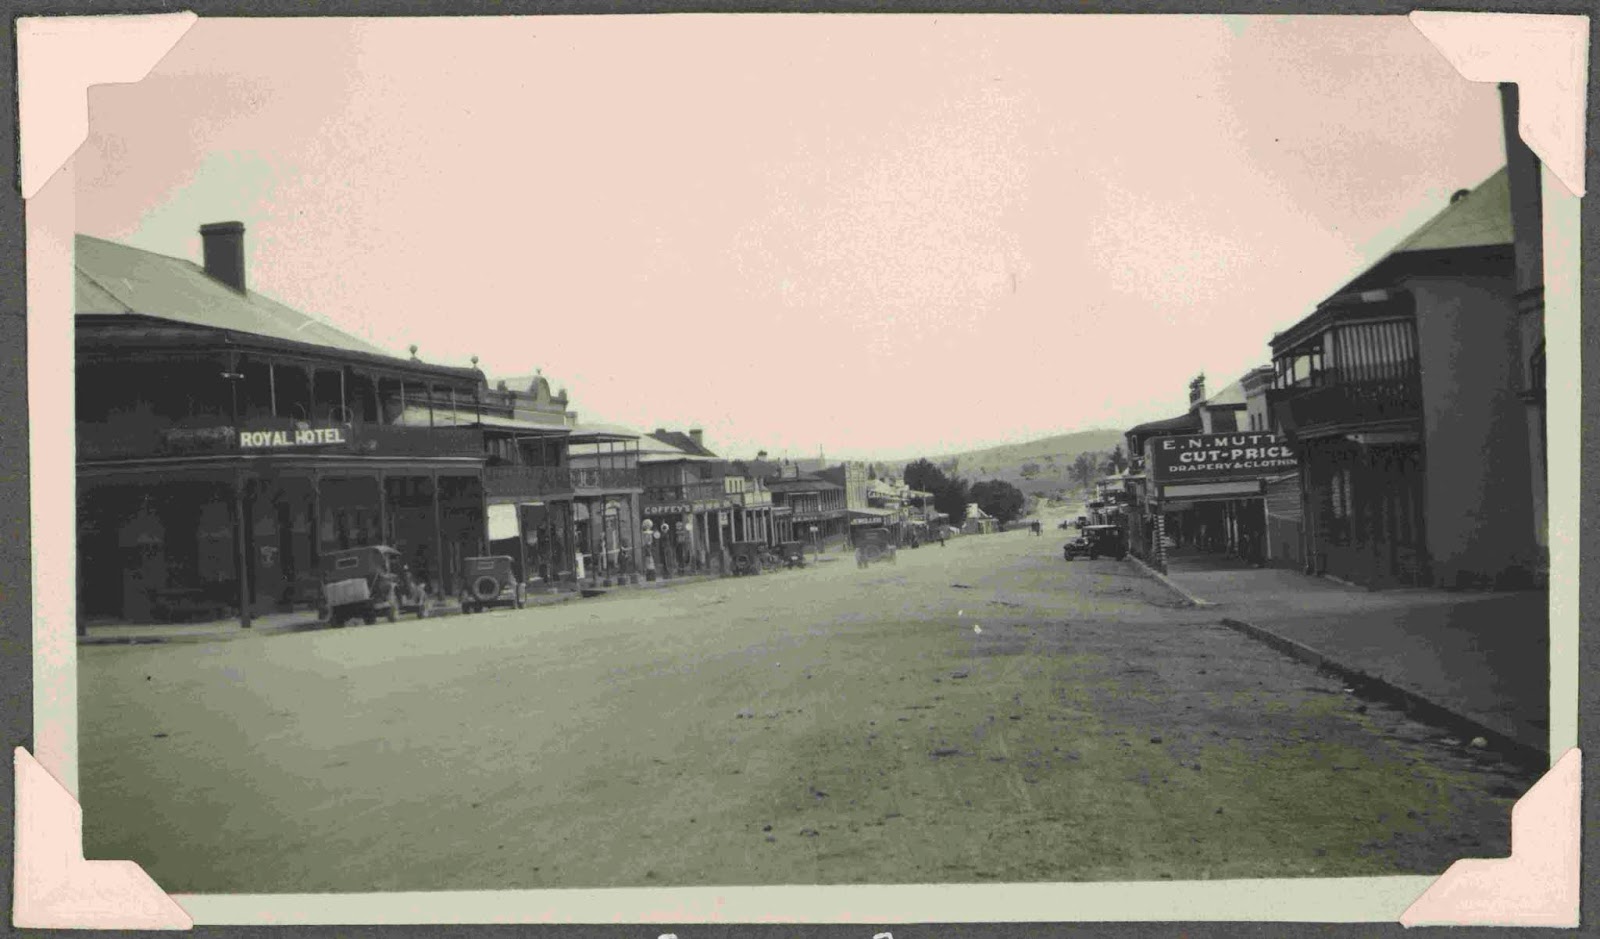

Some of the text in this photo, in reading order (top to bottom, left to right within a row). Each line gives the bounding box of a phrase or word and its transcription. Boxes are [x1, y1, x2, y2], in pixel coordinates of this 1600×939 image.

[240, 430, 294, 447] ROYAL
[295, 428, 345, 445] HOTEL
[1179, 446, 1294, 463] CUT-PRICE
